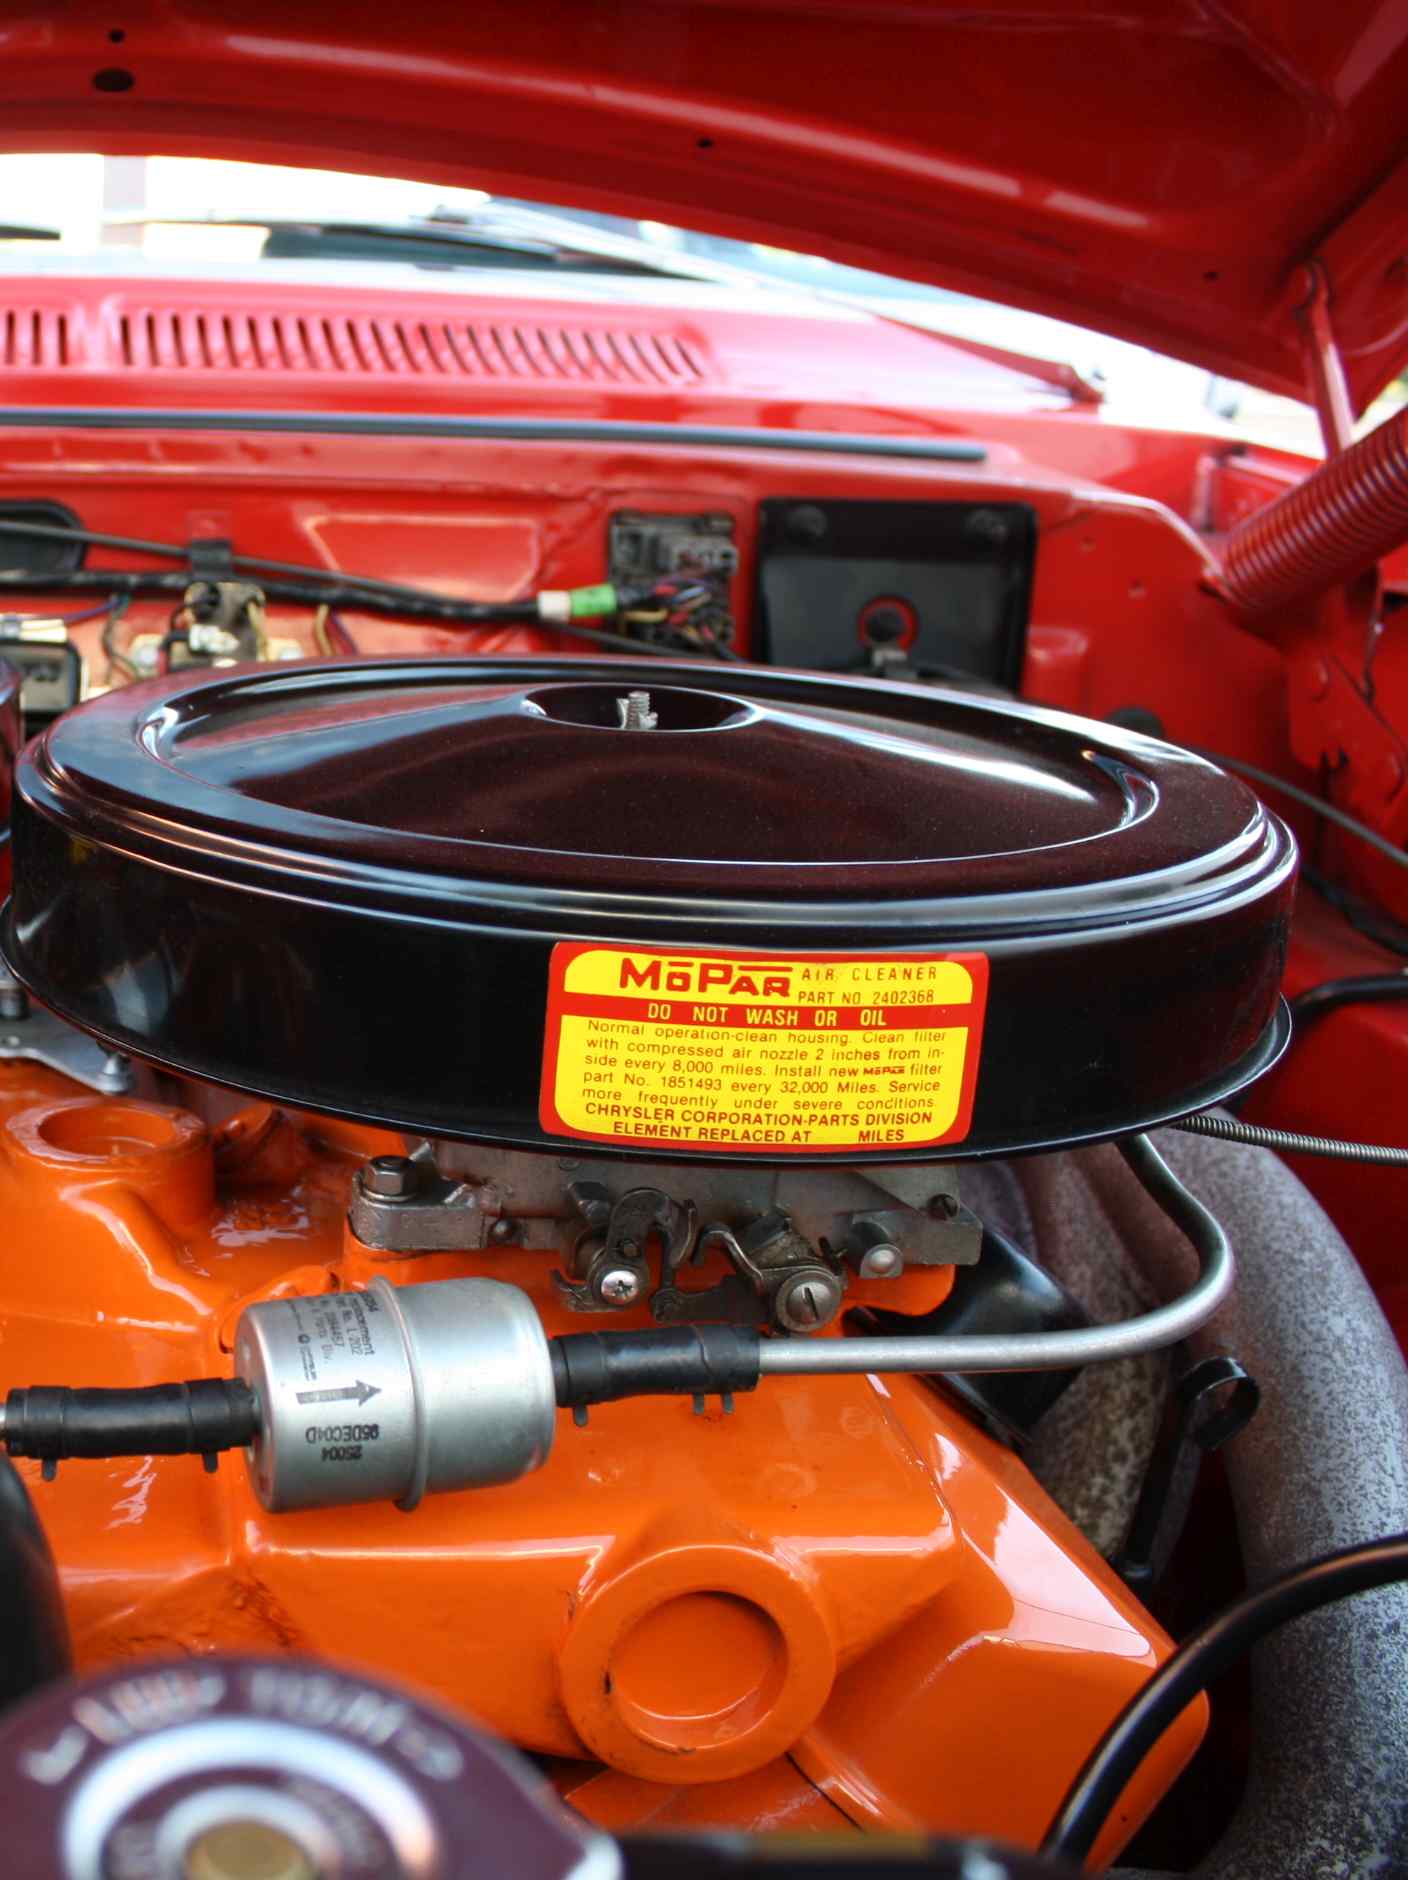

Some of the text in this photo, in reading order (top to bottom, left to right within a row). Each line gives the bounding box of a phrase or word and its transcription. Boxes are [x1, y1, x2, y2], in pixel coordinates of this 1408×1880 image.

[801, 966, 938, 981] AIR CLEANER
[798, 990, 835, 1004] PART
[872, 989, 935, 1005] 2402368
[647, 1002, 887, 1027] DO NOT WASH OR OIL
[587, 1019, 645, 1036] Normal
[862, 1031, 905, 1044] Clean
[913, 1030, 947, 1042] filter
[586, 1037, 945, 1061] with compressed air nozzle 2 inches from in-
[584, 1055, 617, 1068] side
[624, 1058, 665, 1073] every
[672, 1059, 714, 1075] 8,000
[720, 1062, 767, 1076] miles.
[774, 1064, 822, 1077] Install
[828, 1066, 859, 1077] new
[910, 1064, 942, 1075] filter
[583, 1071, 614, 1084] part
[661, 1076, 722, 1091] 1851493
[730, 1082, 771, 1094] every
[779, 1081, 828, 1096] 32,000
[888, 1080, 940, 1093] Service
[582, 1088, 622, 1101] more
[638, 1091, 718, 1109] frequently
[733, 1097, 779, 1110] under
[793, 1099, 843, 1110] severe
[585, 1102, 675, 1122] CHRYSLER
[865, 1112, 933, 1126] DIVISION
[613, 1121, 905, 1142] ELEMENT REPLACED AT MILES
